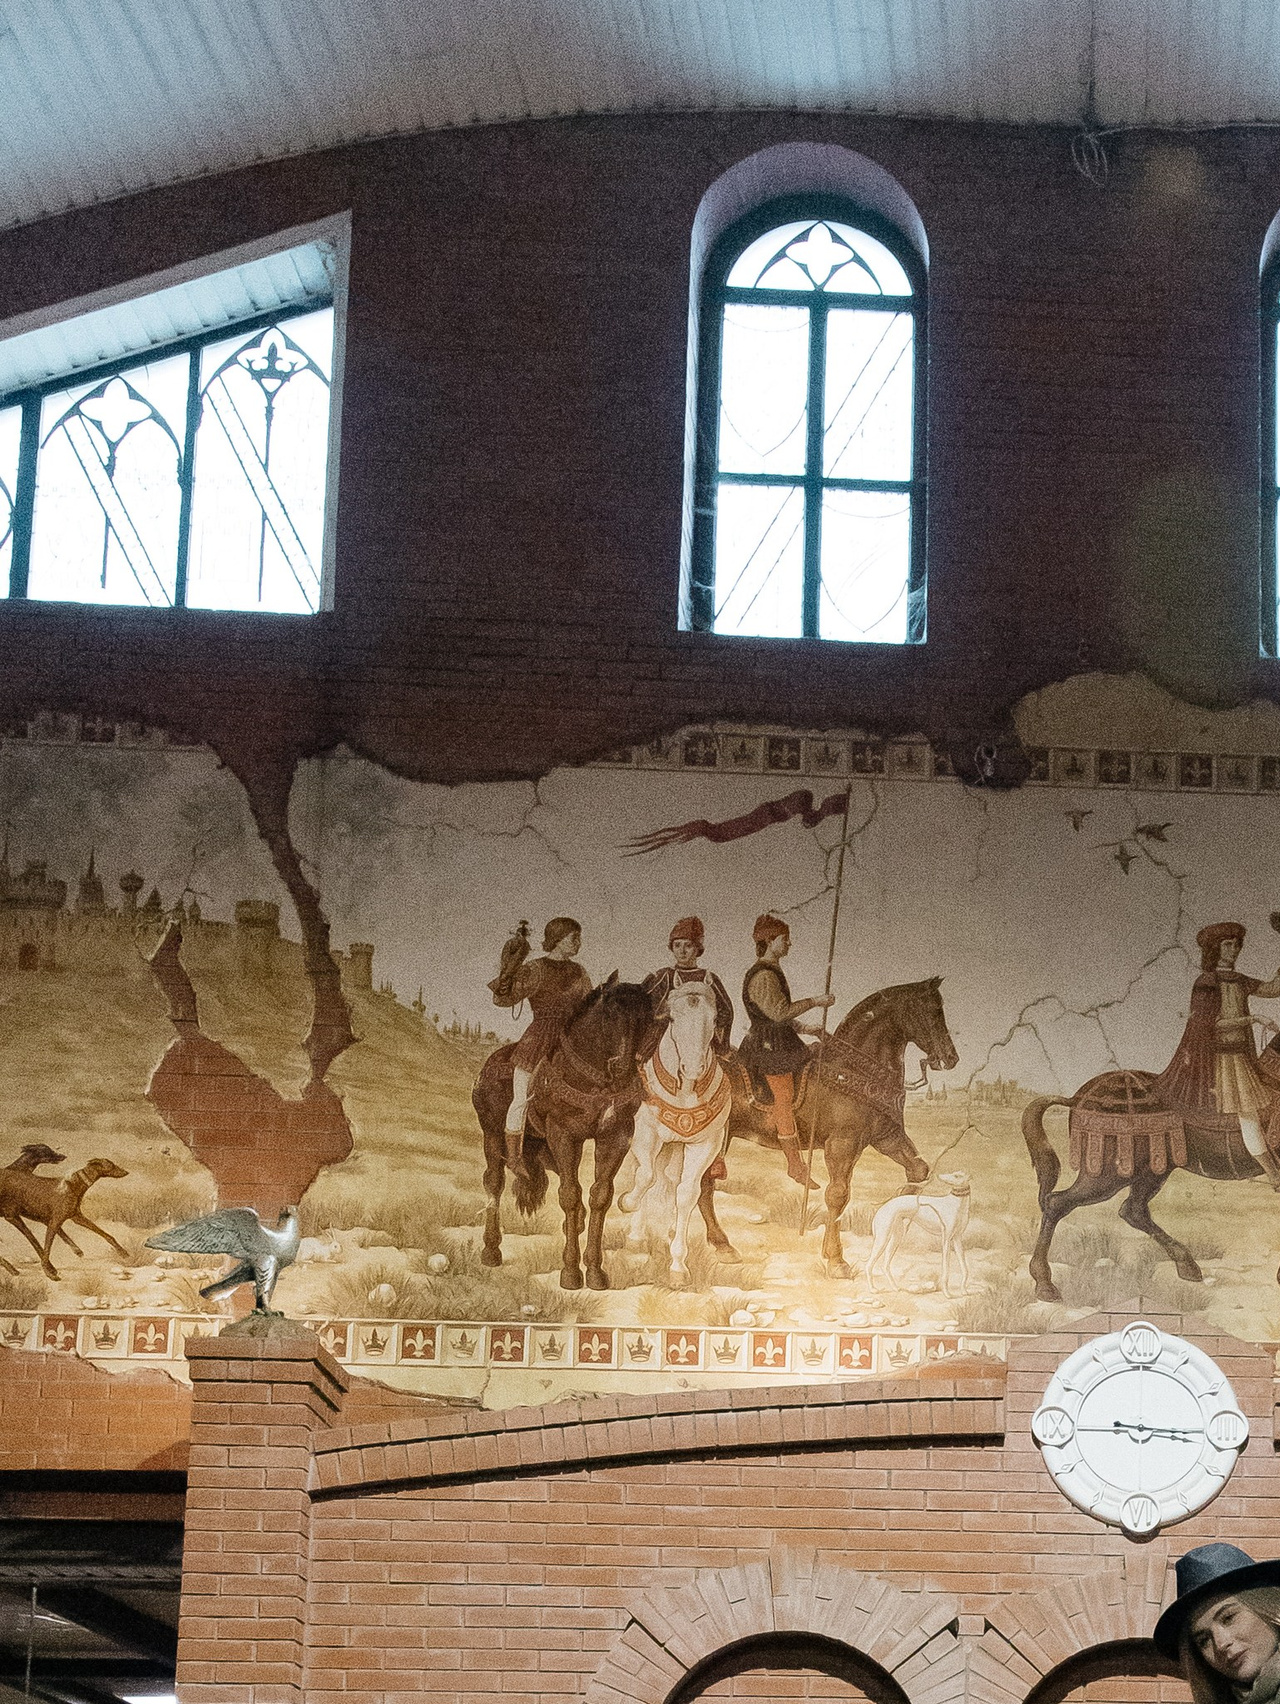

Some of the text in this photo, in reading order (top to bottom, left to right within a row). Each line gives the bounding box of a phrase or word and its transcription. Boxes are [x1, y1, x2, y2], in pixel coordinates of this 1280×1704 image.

[1128, 1330, 1155, 1356] XII
[1041, 1413, 1068, 1439] IX
[1216, 1413, 1238, 1440] III
[1128, 1499, 1153, 1527] VI
